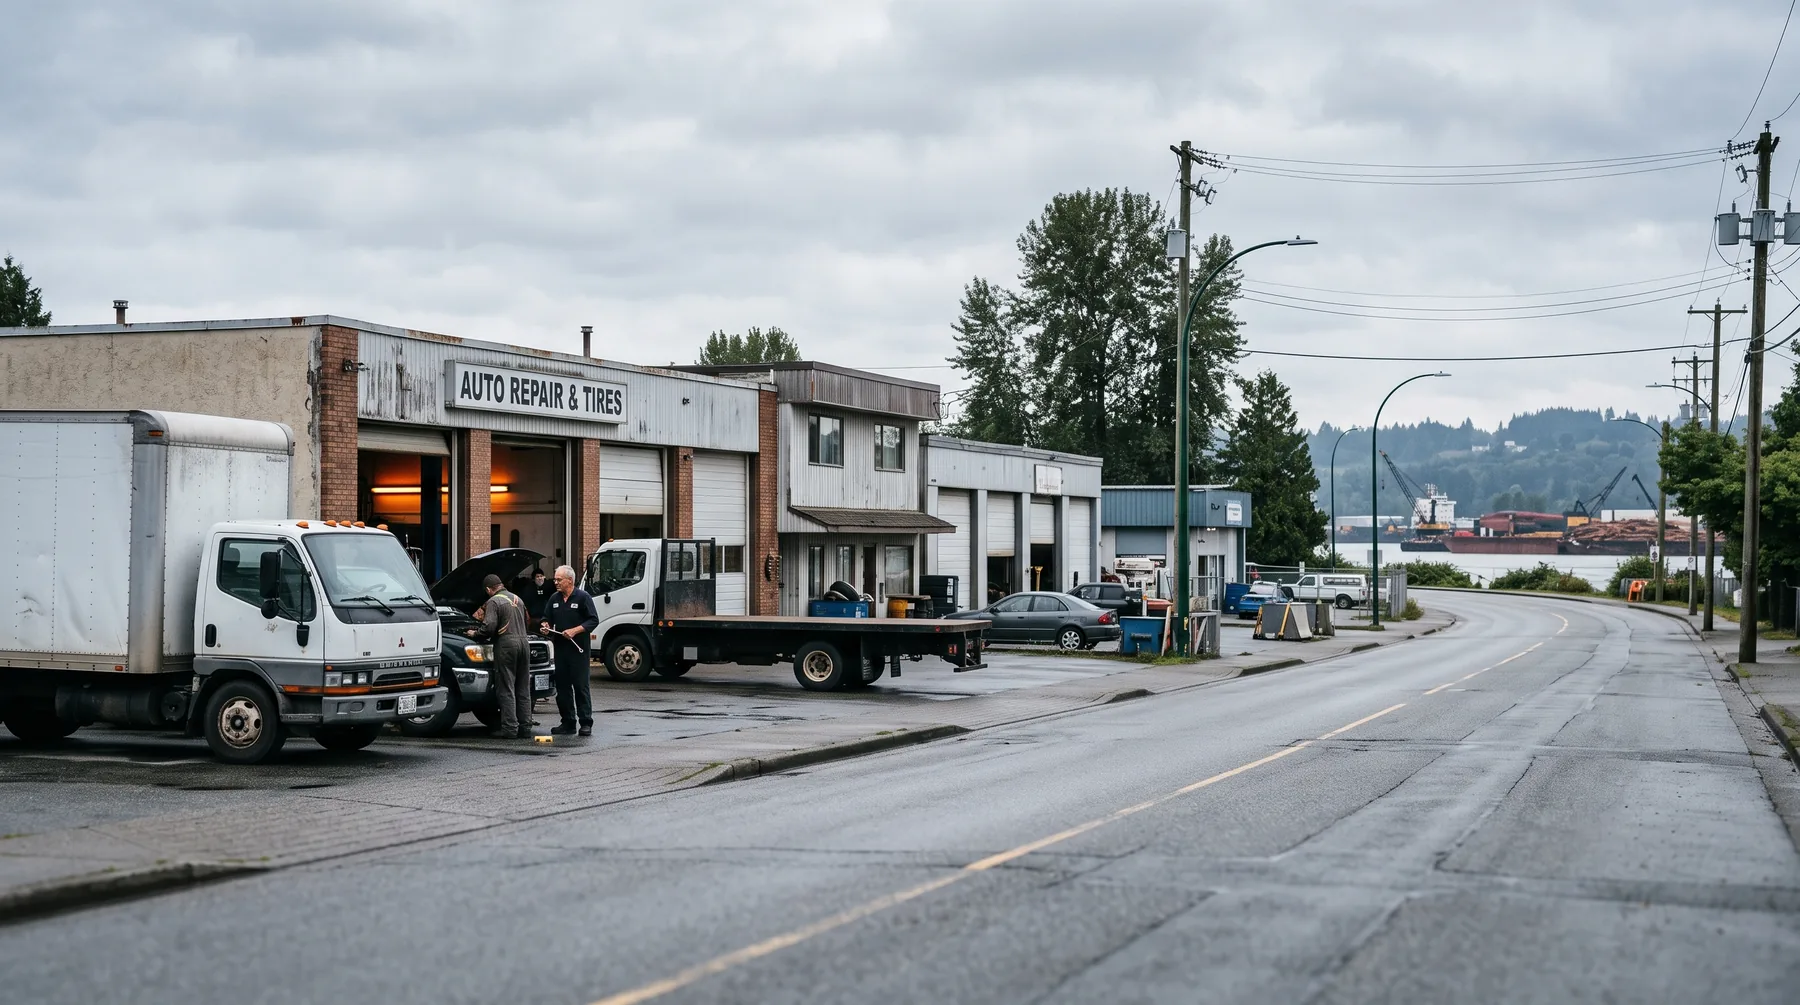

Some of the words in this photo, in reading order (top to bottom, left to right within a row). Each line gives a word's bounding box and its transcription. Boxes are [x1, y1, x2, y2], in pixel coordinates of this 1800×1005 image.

[460, 370, 505, 404] AUTO
[510, 376, 564, 410] REPAIR
[568, 383, 579, 411] &
[582, 385, 622, 416] TIRES
